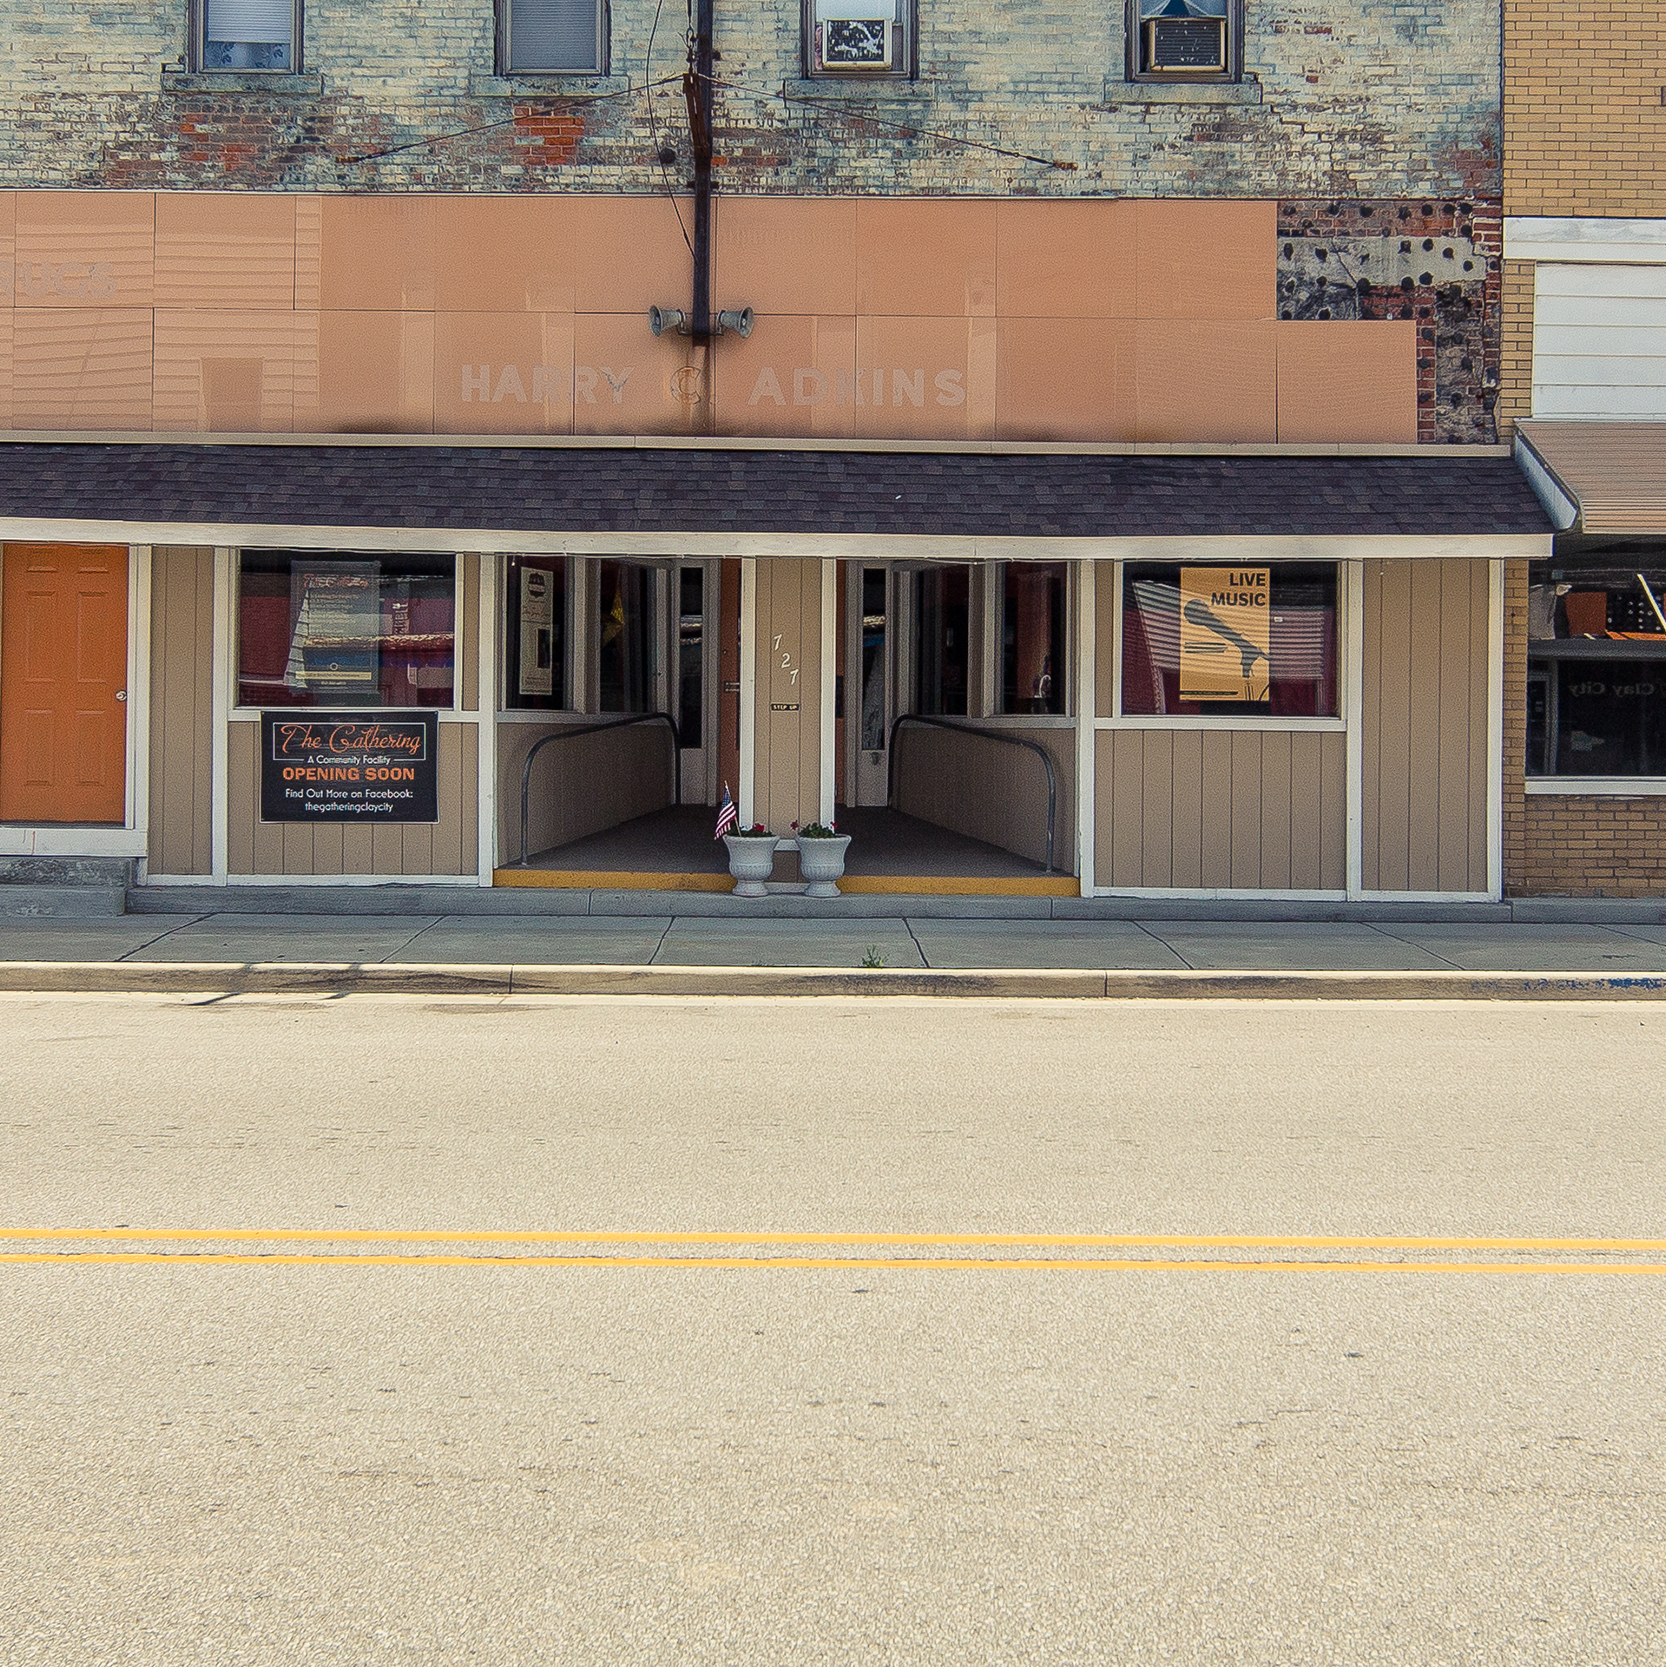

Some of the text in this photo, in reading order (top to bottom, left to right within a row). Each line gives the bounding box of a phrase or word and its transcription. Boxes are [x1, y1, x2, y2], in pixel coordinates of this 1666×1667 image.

[461, 364, 634, 404] HARRY
[747, 367, 967, 407] ADKINS
[1229, 573, 1266, 586] LIVE
[1211, 593, 1266, 606] MUSIC
[281, 724, 421, 755] The Gathering
[307, 755, 314, 764] A
[316, 755, 361, 766] Community
[283, 767, 415, 781] OPENING SOON
[285, 788, 304, 798] Find
[306, 789, 323, 798] Out
[326, 789, 348, 798] More
[365, 788, 414, 798] Facebook:
